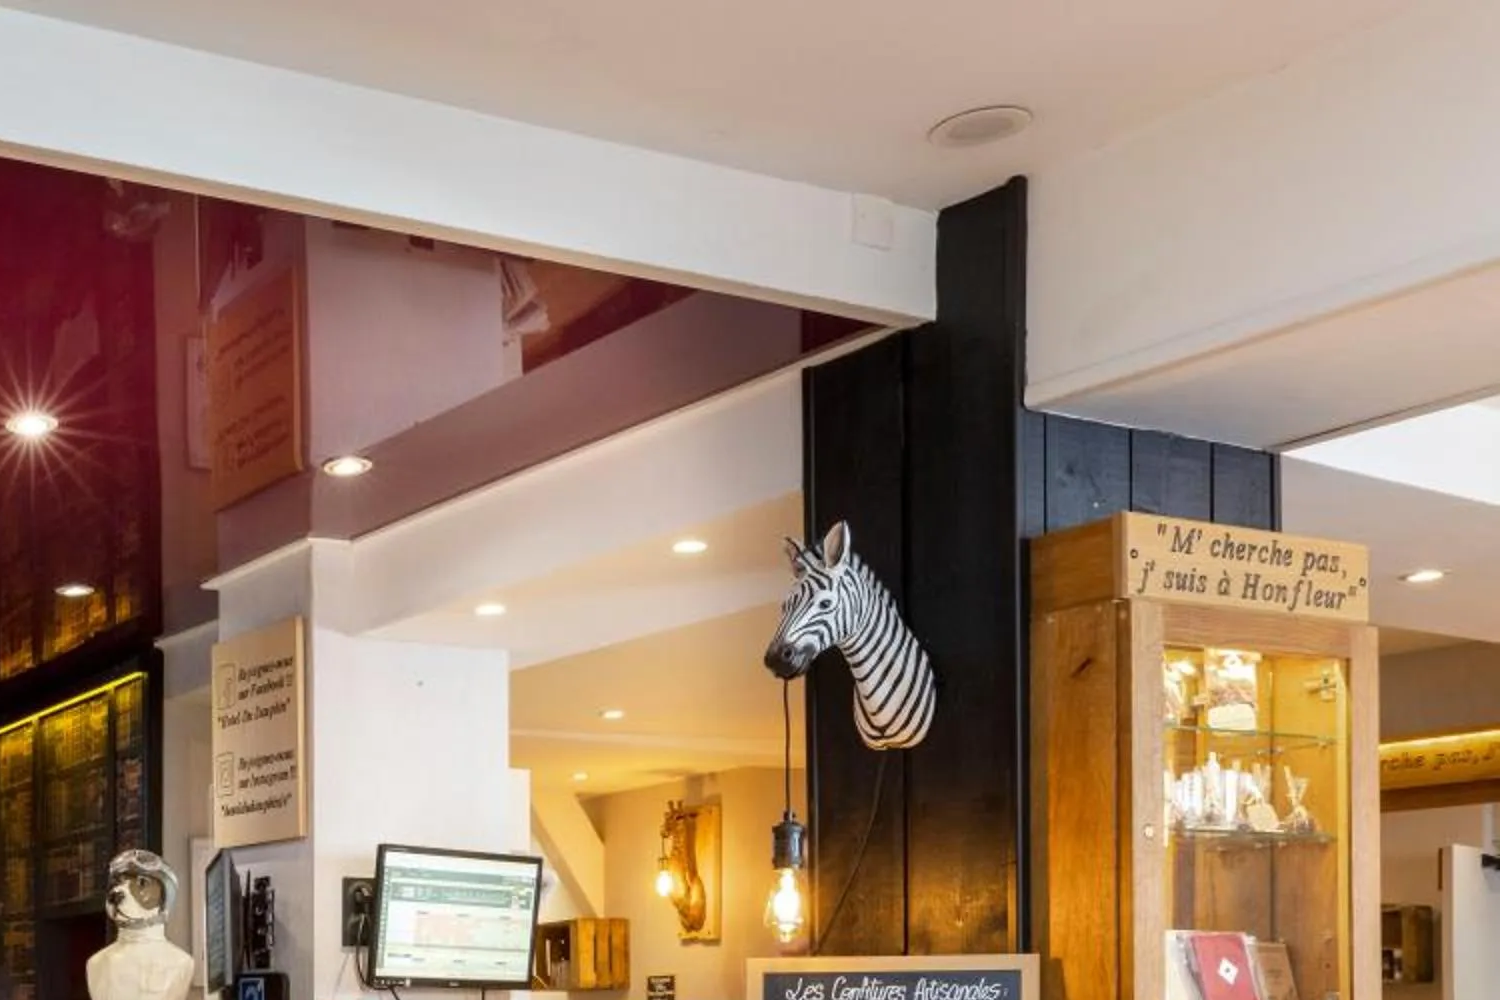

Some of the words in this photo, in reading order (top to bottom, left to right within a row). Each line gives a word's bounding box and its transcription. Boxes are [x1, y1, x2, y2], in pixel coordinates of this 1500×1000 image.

[1210, 533, 1292, 567] cherche
[1302, 550, 1347, 579] pas,
[1164, 566, 1207, 594] suis
[1217, 571, 1230, 596] à
